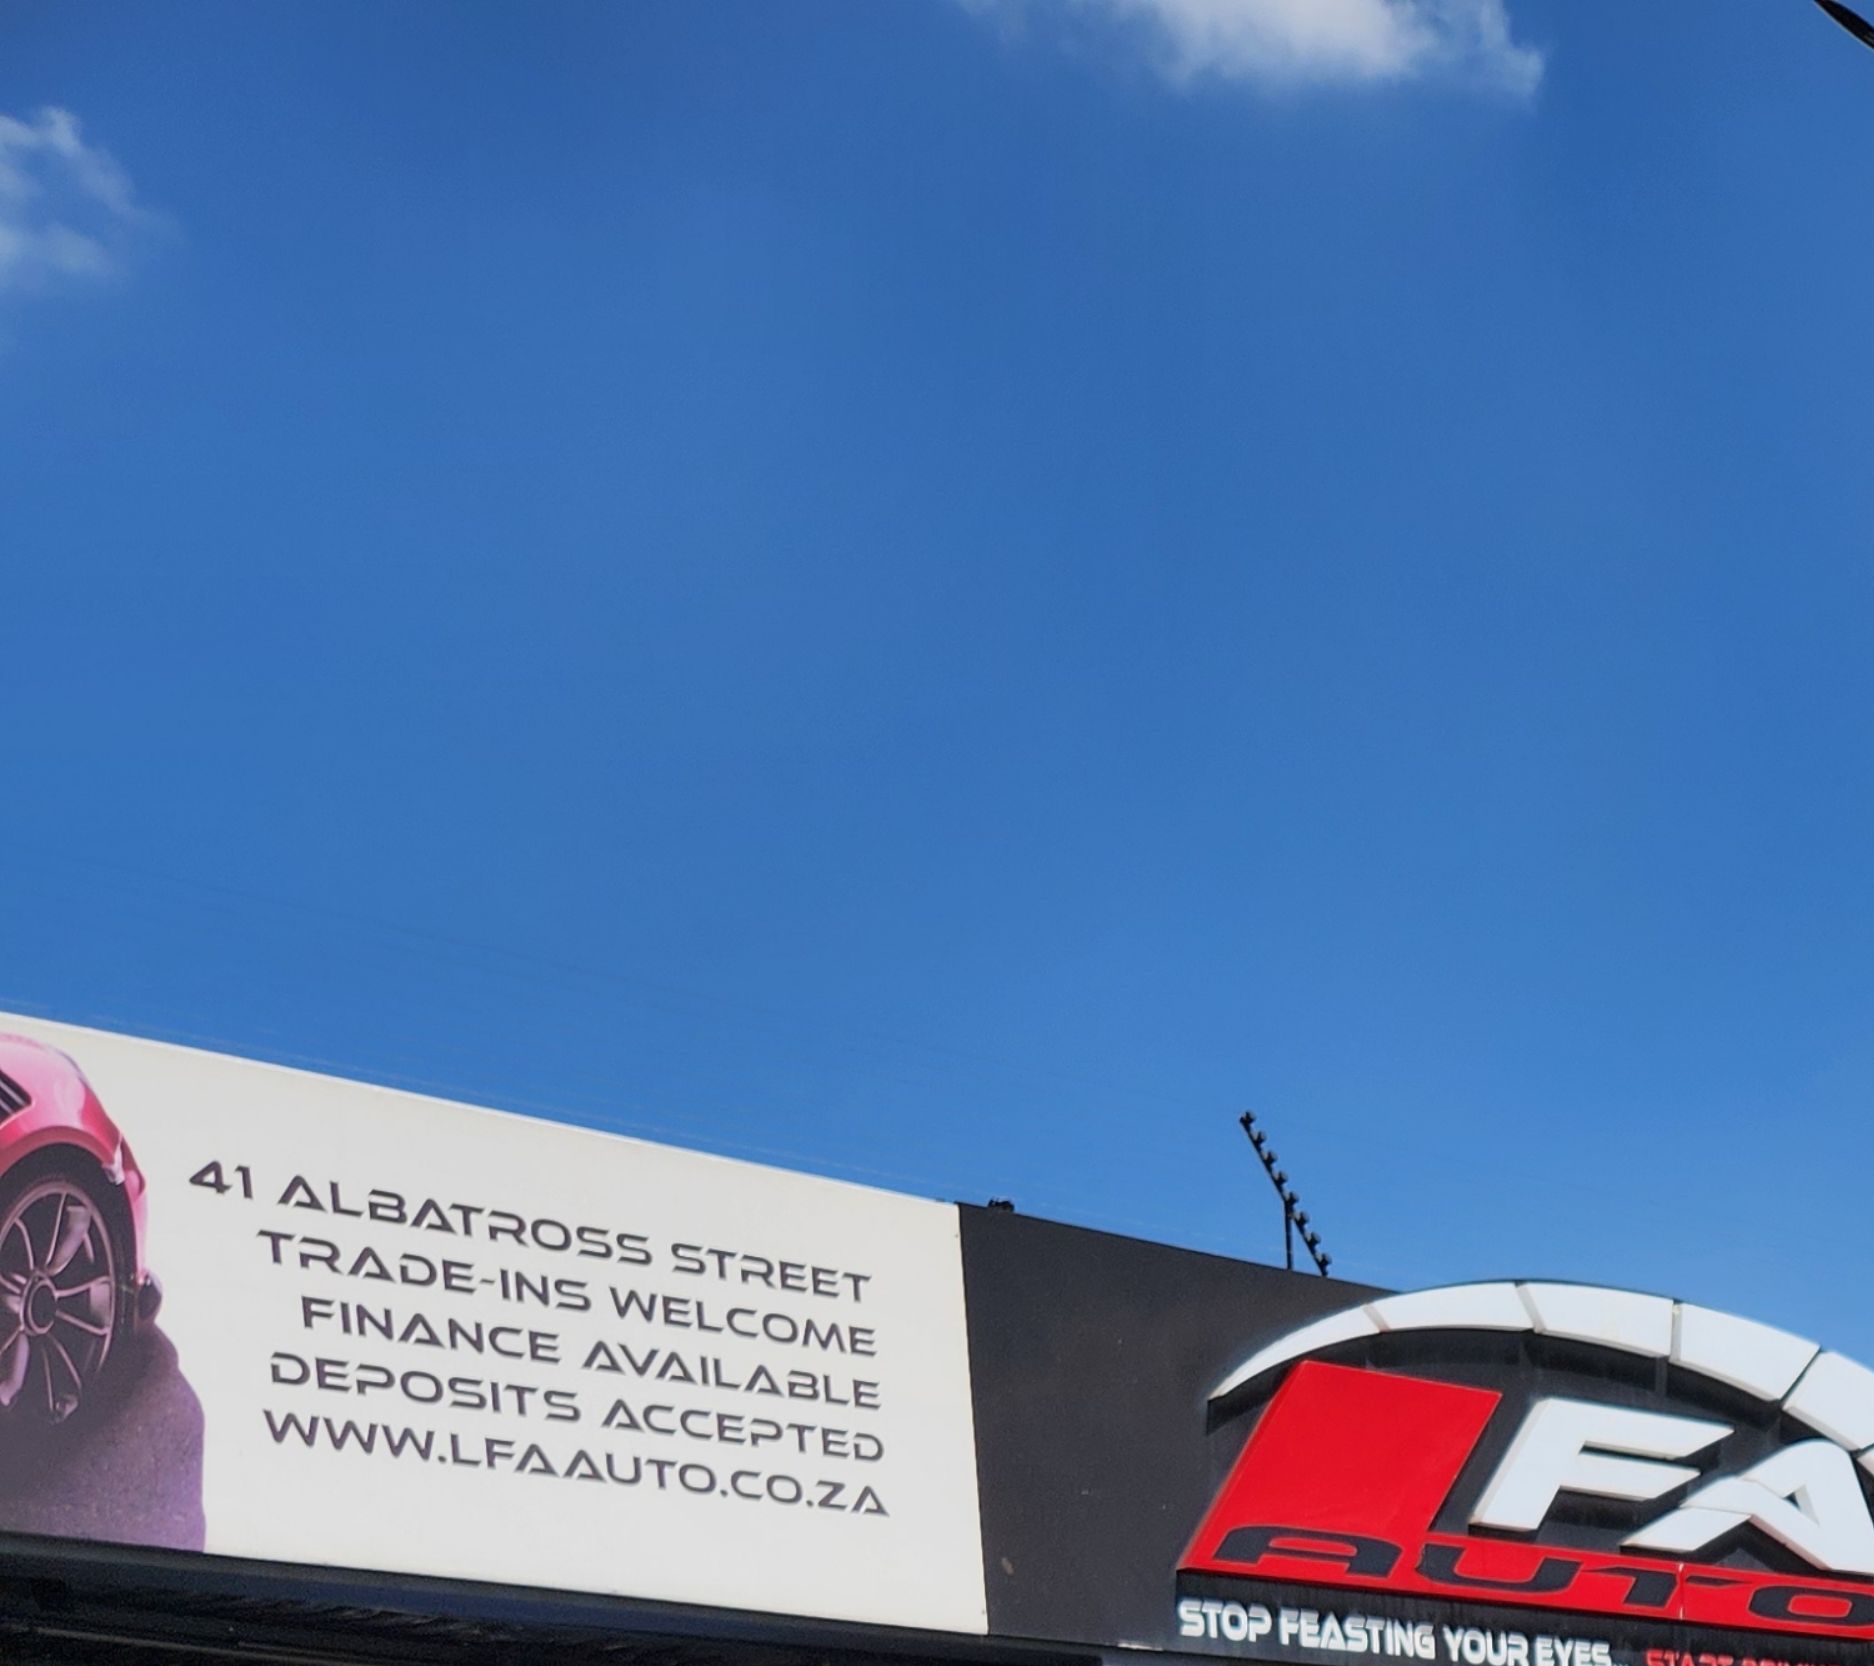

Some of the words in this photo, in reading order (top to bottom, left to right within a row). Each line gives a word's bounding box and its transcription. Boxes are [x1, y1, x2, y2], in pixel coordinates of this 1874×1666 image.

[189, 1160, 253, 1199] 41
[277, 1175, 652, 1266] ALBATROSS
[671, 1243, 871, 1302] STREET
[257, 1229, 591, 1311] TRADE-INS
[609, 1286, 876, 1357] WELCOME
[270, 1351, 581, 1422] DEPOSITS
[602, 1399, 883, 1461] ACCEPTED
[301, 1295, 560, 1364] FINANCE
[583, 1340, 880, 1410] AVAILABLE
[263, 1410, 888, 1516] WWW.LFAAUTO.CO.ZA
[1178, 1599, 1273, 1643] STOP
[1278, 1609, 1436, 1660] FEASTING
